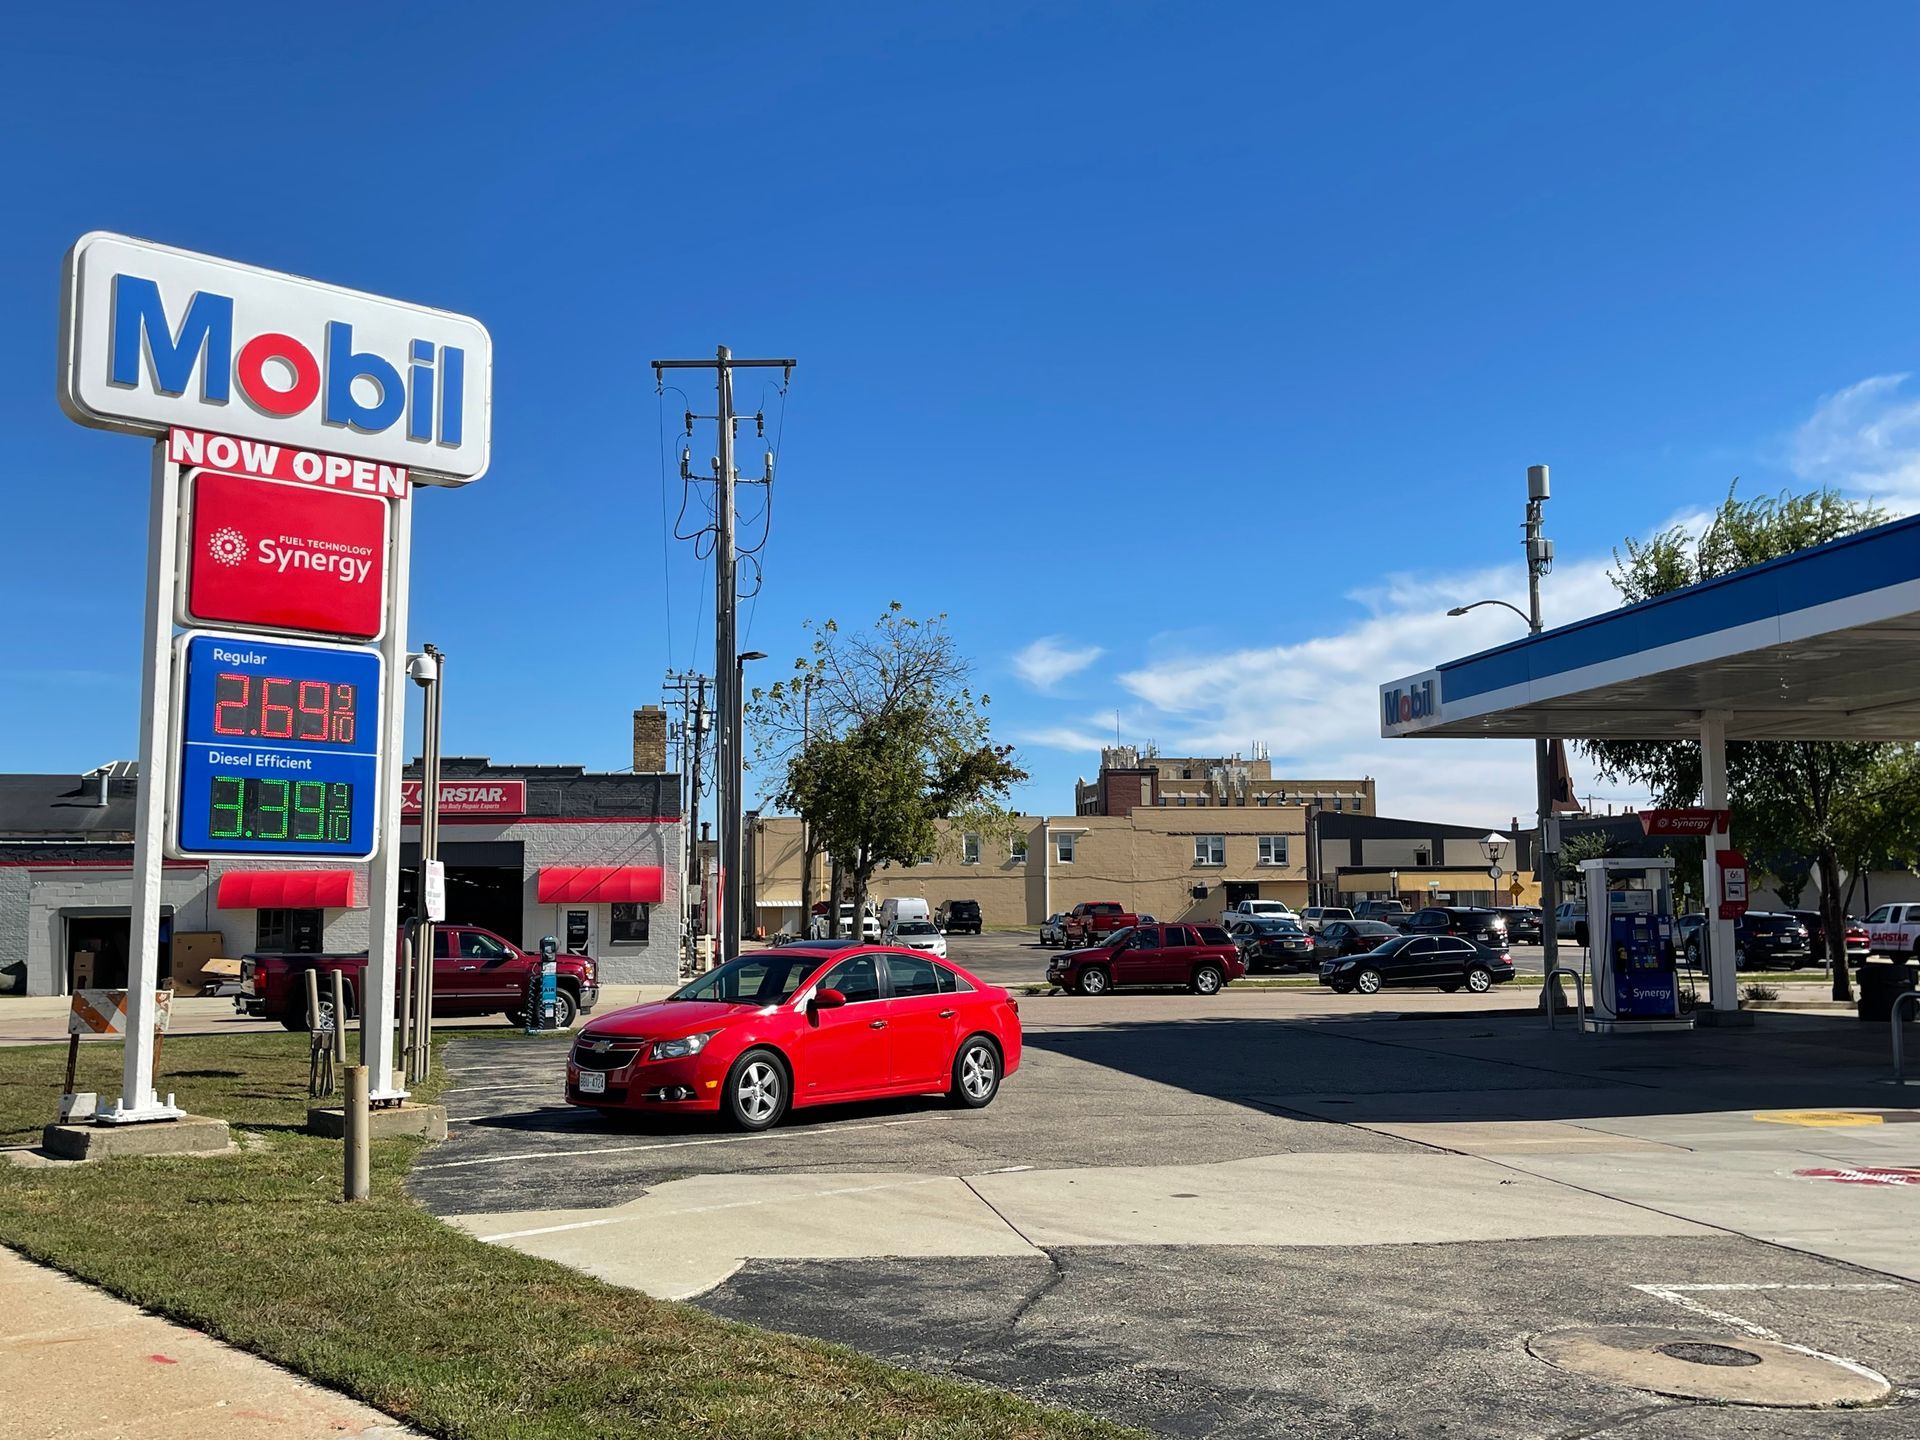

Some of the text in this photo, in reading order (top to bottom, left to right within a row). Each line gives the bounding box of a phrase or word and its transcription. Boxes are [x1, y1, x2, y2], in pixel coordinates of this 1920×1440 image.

[107, 273, 464, 449] Mobil
[173, 430, 406, 497] NOW OPEN
[279, 535, 373, 556] FUEL TECHNOLOGY
[258, 538, 372, 583] Synergy
[213, 648, 267, 666] Regular
[214, 673, 331, 741] 2.69
[1385, 680, 1433, 726] Mobil
[209, 751, 312, 770] Diesel Efficient
[416, 787, 503, 802] RSTAR
[211, 775, 326, 840] 3.39
[1671, 818, 1710, 829] Synergy
[1871, 932, 1909, 942] CARSTAR
[1633, 988, 1671, 999] Synergy
